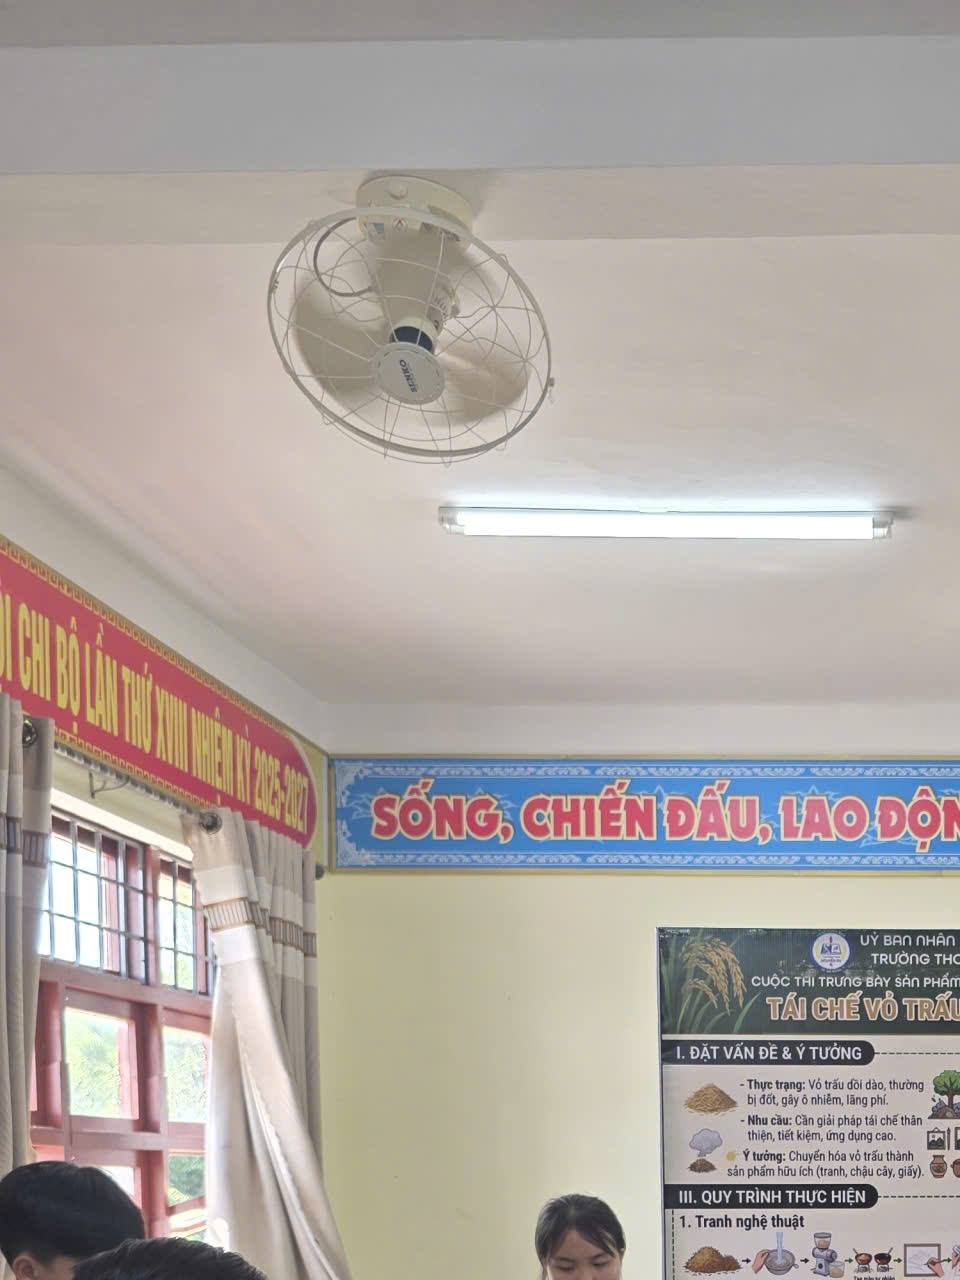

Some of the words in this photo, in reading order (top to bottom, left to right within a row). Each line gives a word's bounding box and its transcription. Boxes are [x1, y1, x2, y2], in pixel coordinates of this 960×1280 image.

[18, 603, 50, 701] CHI
[56, 617, 80, 735] BỘ
[85, 623, 118, 736] LẦN
[122, 662, 153, 754] THỨ
[155, 683, 188, 772] XVIII
[236, 725, 251, 803] KỲ
[254, 747, 309, 834] 2025-2027
[371, 779, 514, 847] SỐNG,
[520, 778, 656, 841] CHIẾN
[664, 778, 774, 846] ĐẤU,
[780, 793, 869, 841] LAO
[883, 935, 912, 946] BAN
[915, 932, 956, 946] NHÂN
[872, 951, 930, 965] TRƯỜNG
[751, 972, 791, 989] CUỘC
[794, 976, 814, 987] THI
[819, 975, 863, 988] TRƯNG
[866, 973, 892, 987] BÀY
[895, 972, 920, 987] SẢN
[766, 992, 806, 1021] TÁI
[812, 991, 860, 1021] CHẾ
[864, 991, 899, 1021] VỎ
[676, 1046, 685, 1059] I.
[690, 1046, 720, 1062] ĐẶT
[723, 1043, 753, 1060] VẤN
[759, 1042, 778, 1059] ĐỀ
[782, 1046, 792, 1059] &
[797, 1043, 806, 1059] Ý
[810, 1043, 862, 1059] TƯỞNG
[748, 1078, 773, 1092] Thực
[775, 1080, 806, 1092] trạng:
[809, 1078, 822, 1091] Vỏ
[824, 1078, 845, 1091] trấu
[865, 1078, 886, 1092] dào,
[889, 1078, 924, 1092] thường
[679, 1190, 697, 1203] III.
[702, 1190, 731, 1205] QUY
[736, 1186, 783, 1203] TRÌNH
[786, 1189, 827, 1206] THỰC
[831, 1187, 866, 1206] HIỆN
[680, 1216, 691, 1228] 1.
[696, 1215, 732, 1228] Tranh
[736, 1214, 767, 1230] nghệ
[772, 1214, 805, 1230] thuật
